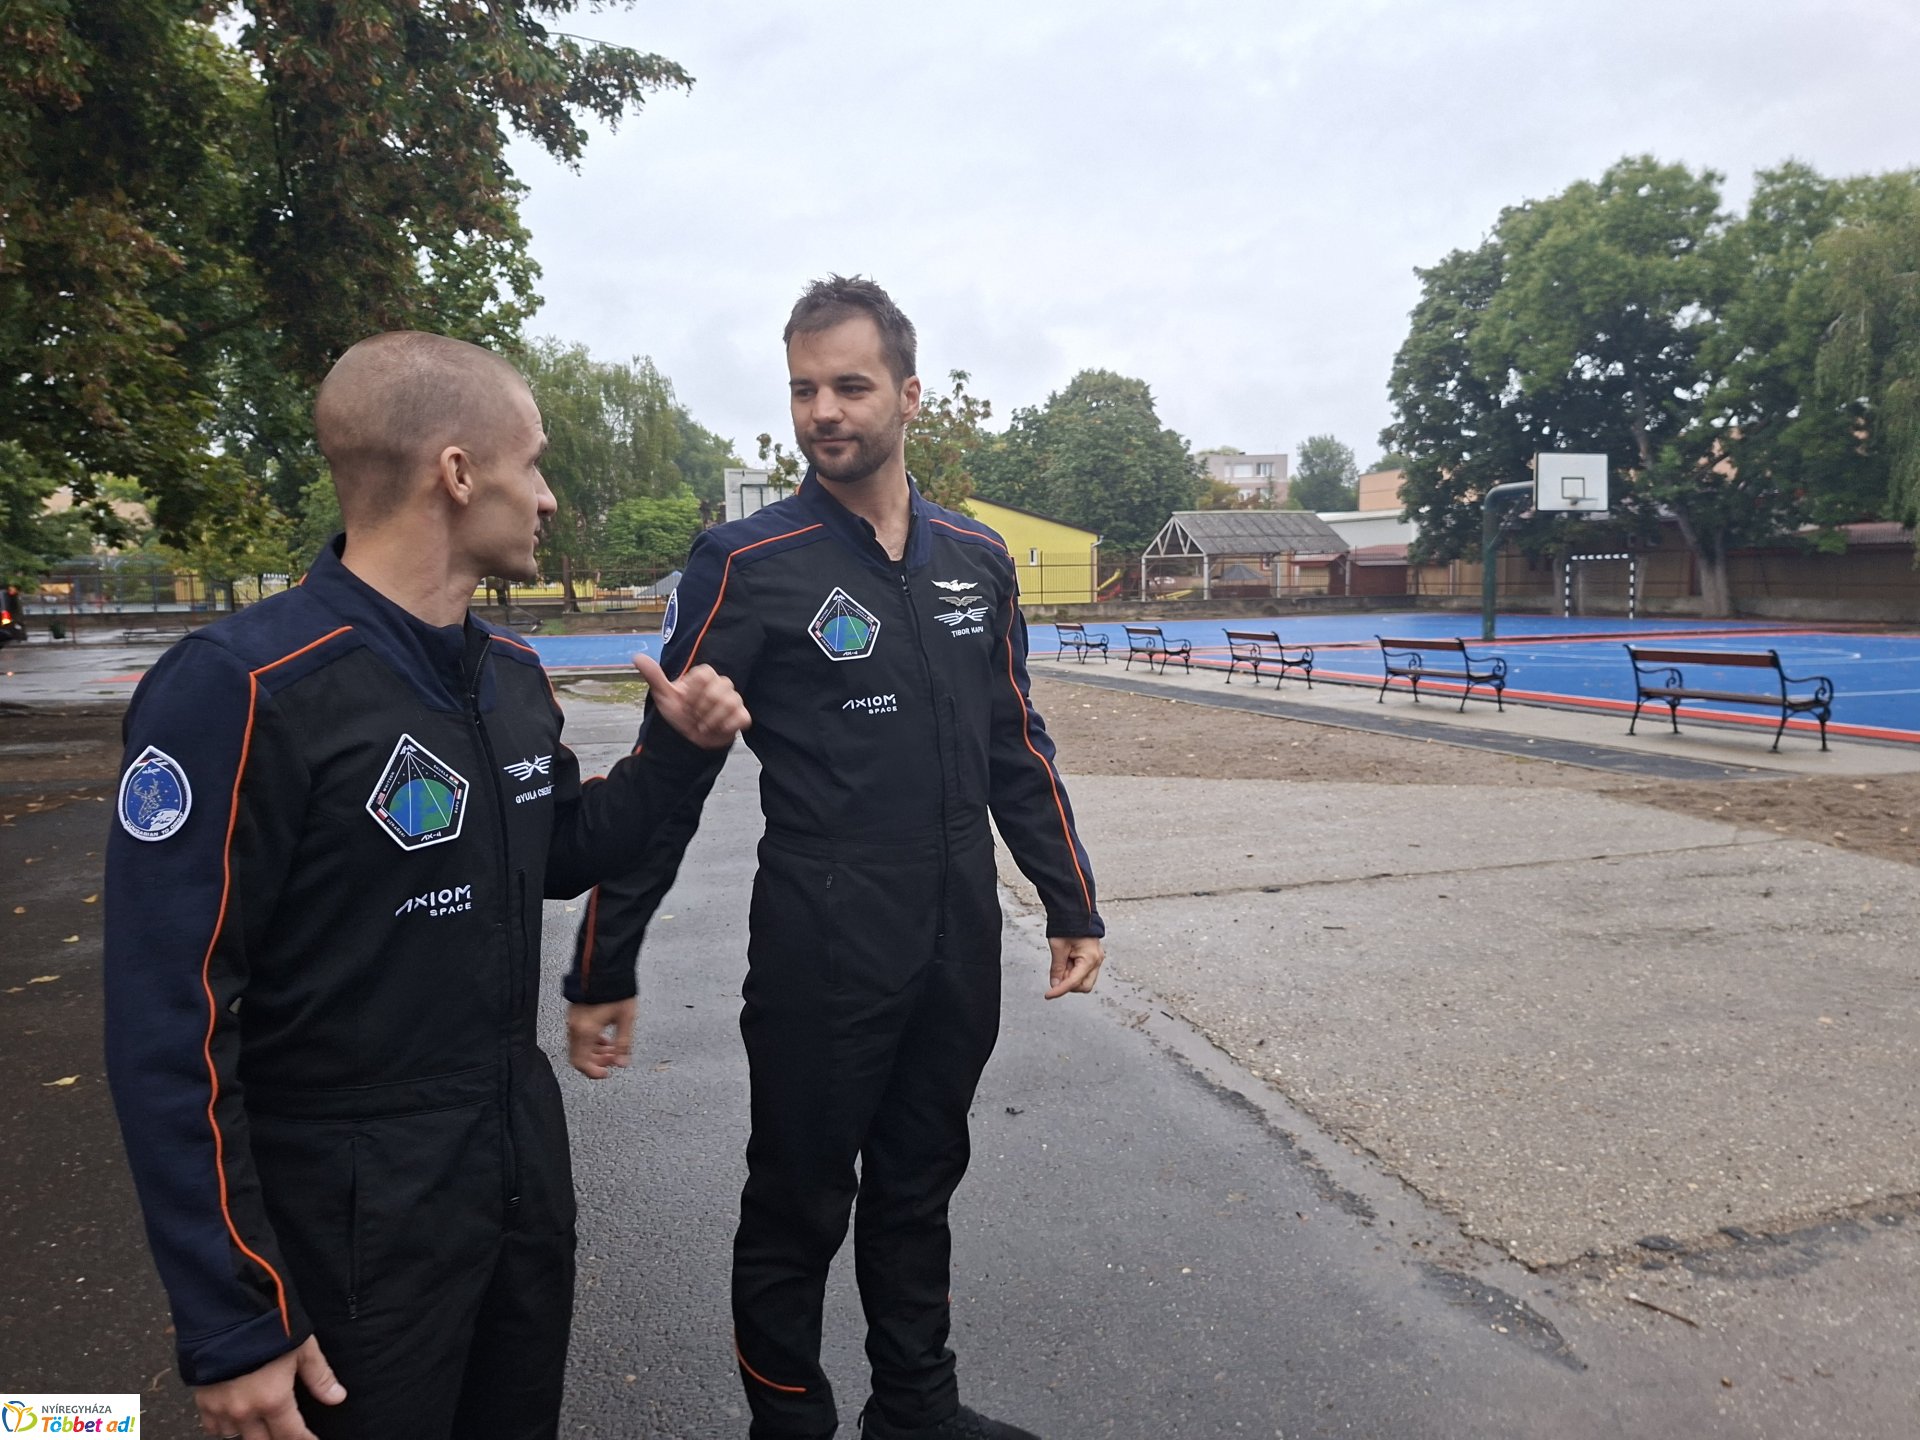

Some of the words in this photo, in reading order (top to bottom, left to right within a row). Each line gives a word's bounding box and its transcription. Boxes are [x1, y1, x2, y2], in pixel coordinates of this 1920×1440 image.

[951, 627, 970, 638] TIBOR
[842, 693, 896, 710] AXIOM
[868, 706, 898, 715] SPACE
[515, 790, 538, 804] GYULA
[125, 819, 159, 837] HUNGARIAN
[420, 831, 442, 842] AX-4
[395, 884, 471, 917] AXIOM
[429, 902, 472, 917] SPACE
